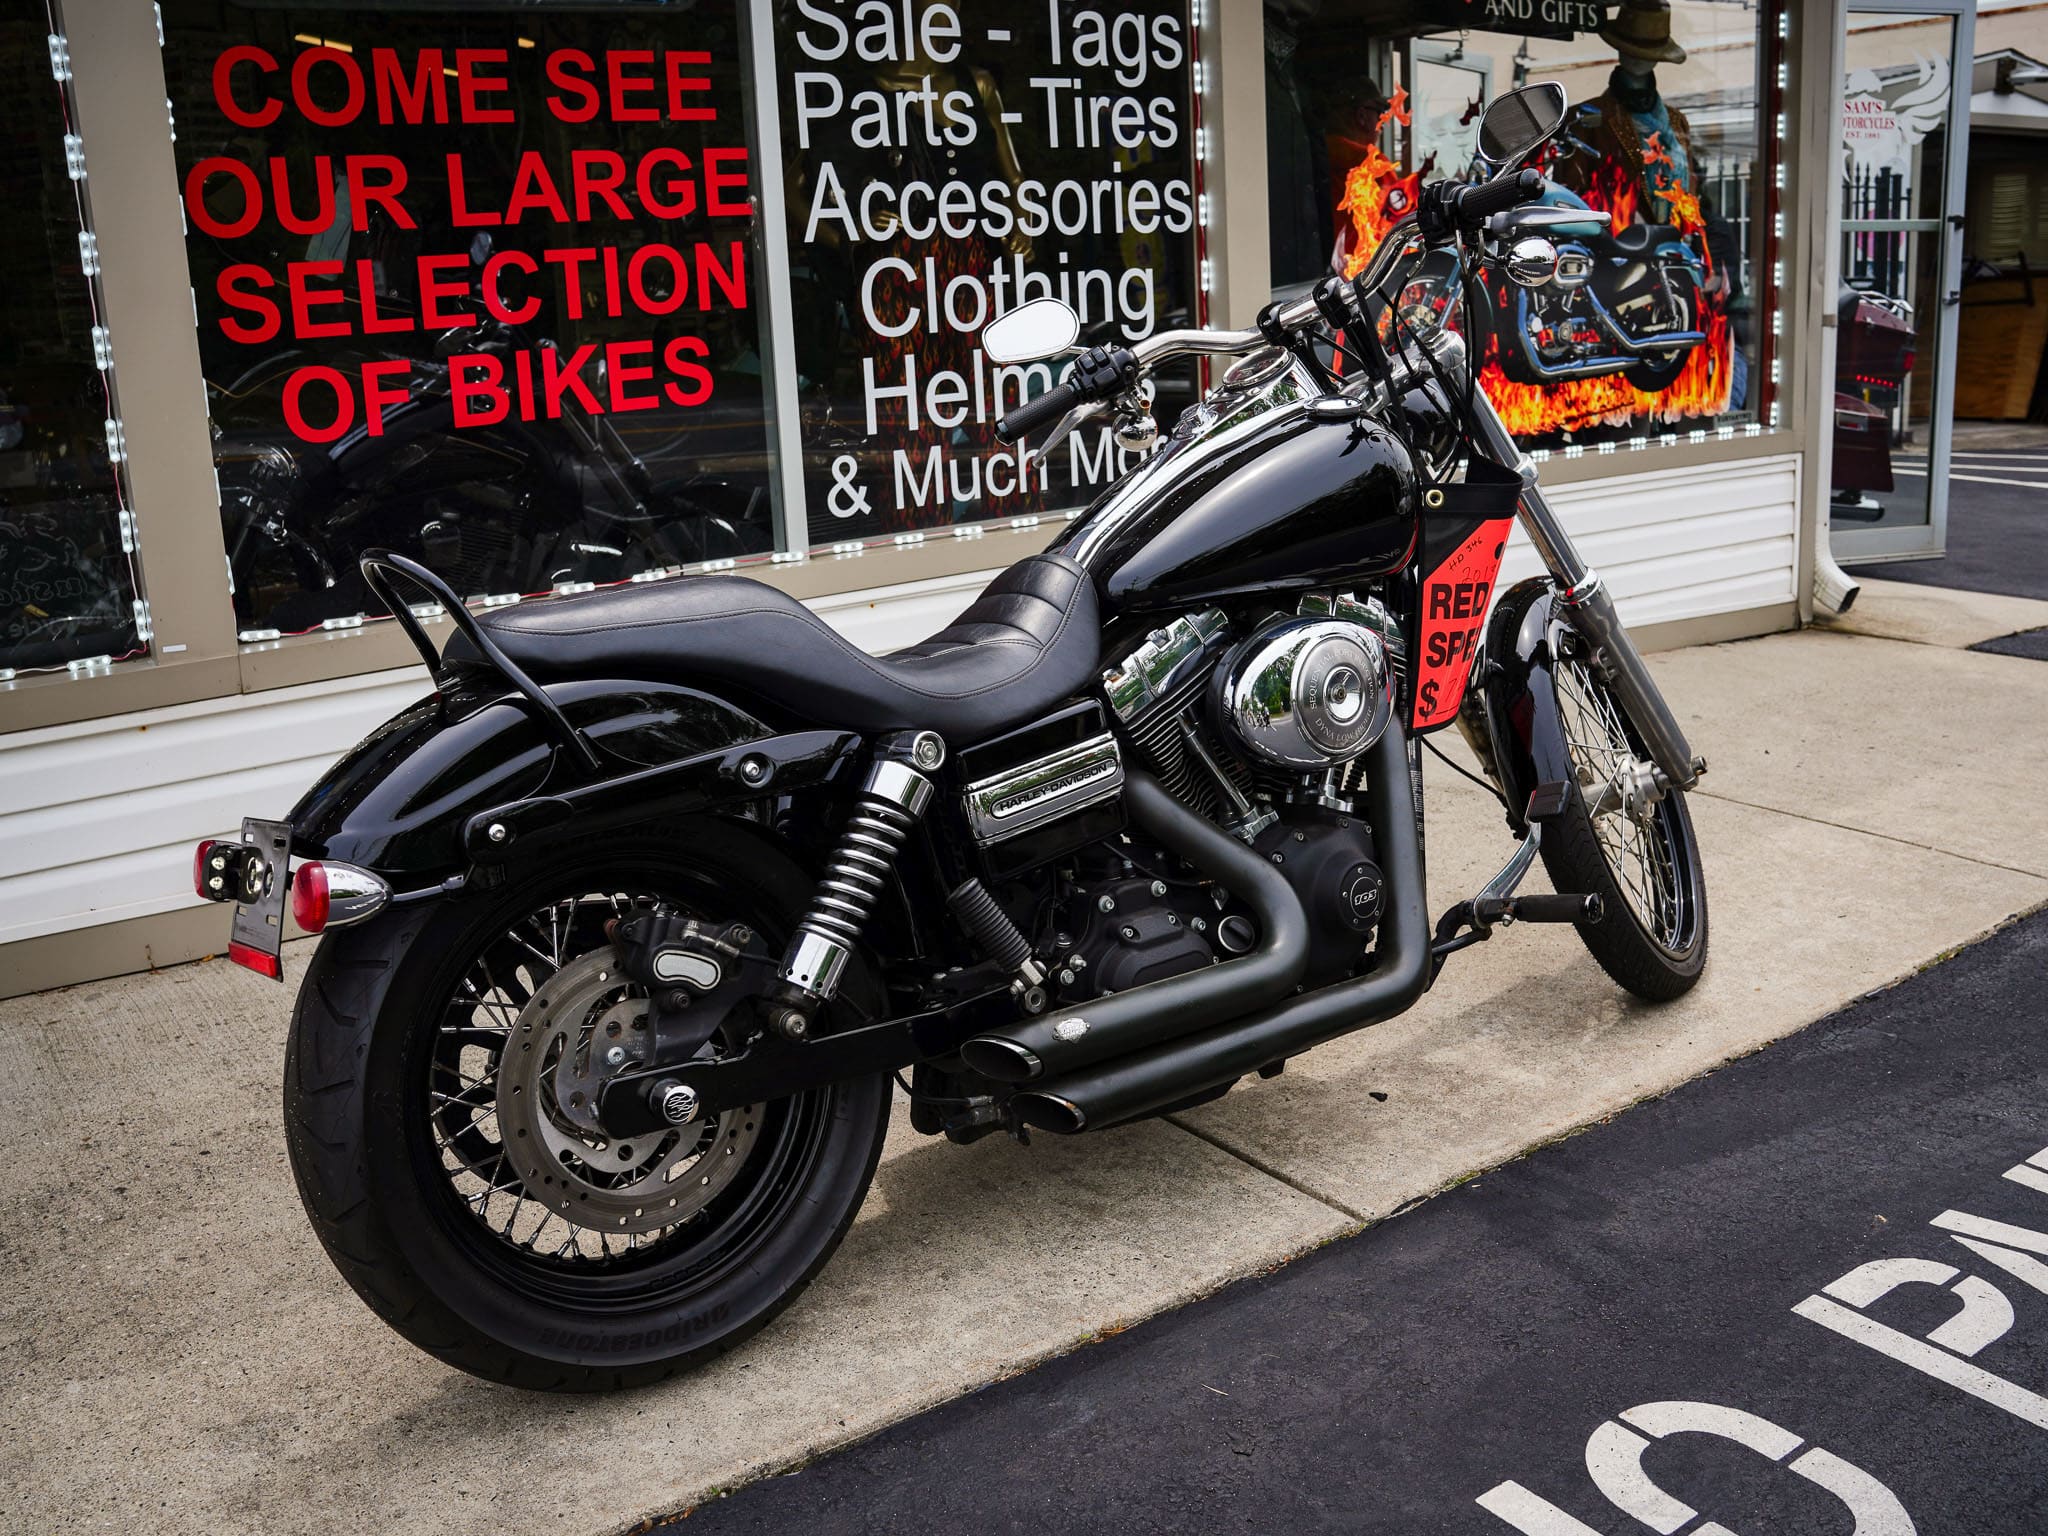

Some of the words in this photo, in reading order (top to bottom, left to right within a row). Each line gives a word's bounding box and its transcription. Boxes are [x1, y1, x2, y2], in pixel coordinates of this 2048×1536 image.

[796, 0, 961, 63] Sale
[1049, 0, 1182, 88] Tags
[1484, 0, 1533, 19] AND
[1541, 0, 1598, 27] GIFTS
[214, 46, 515, 127] COME
[546, 49, 717, 123] SEE
[794, 72, 977, 149] Parts
[1030, 77, 1178, 149] Tires
[1844, 100, 1884, 114] SAM'S
[187, 155, 417, 239] OUR
[446, 147, 754, 227] LARGE
[804, 161, 1193, 243] Accessories
[217, 241, 747, 344] SELECTION
[861, 252, 1156, 341] Clothing
[282, 359, 412, 443] OF
[447, 335, 714, 429] BIKES
[862, 349, 1156, 436] Helm
[827, 454, 872, 518] &
[893, 436, 1049, 511] Much
[1429, 582, 1490, 620] RED
[998, 762, 1110, 812] HARLEY-DAVIDSON
[1475, 1401, 1917, 1536] O
[1790, 1146, 2048, 1429] PA
